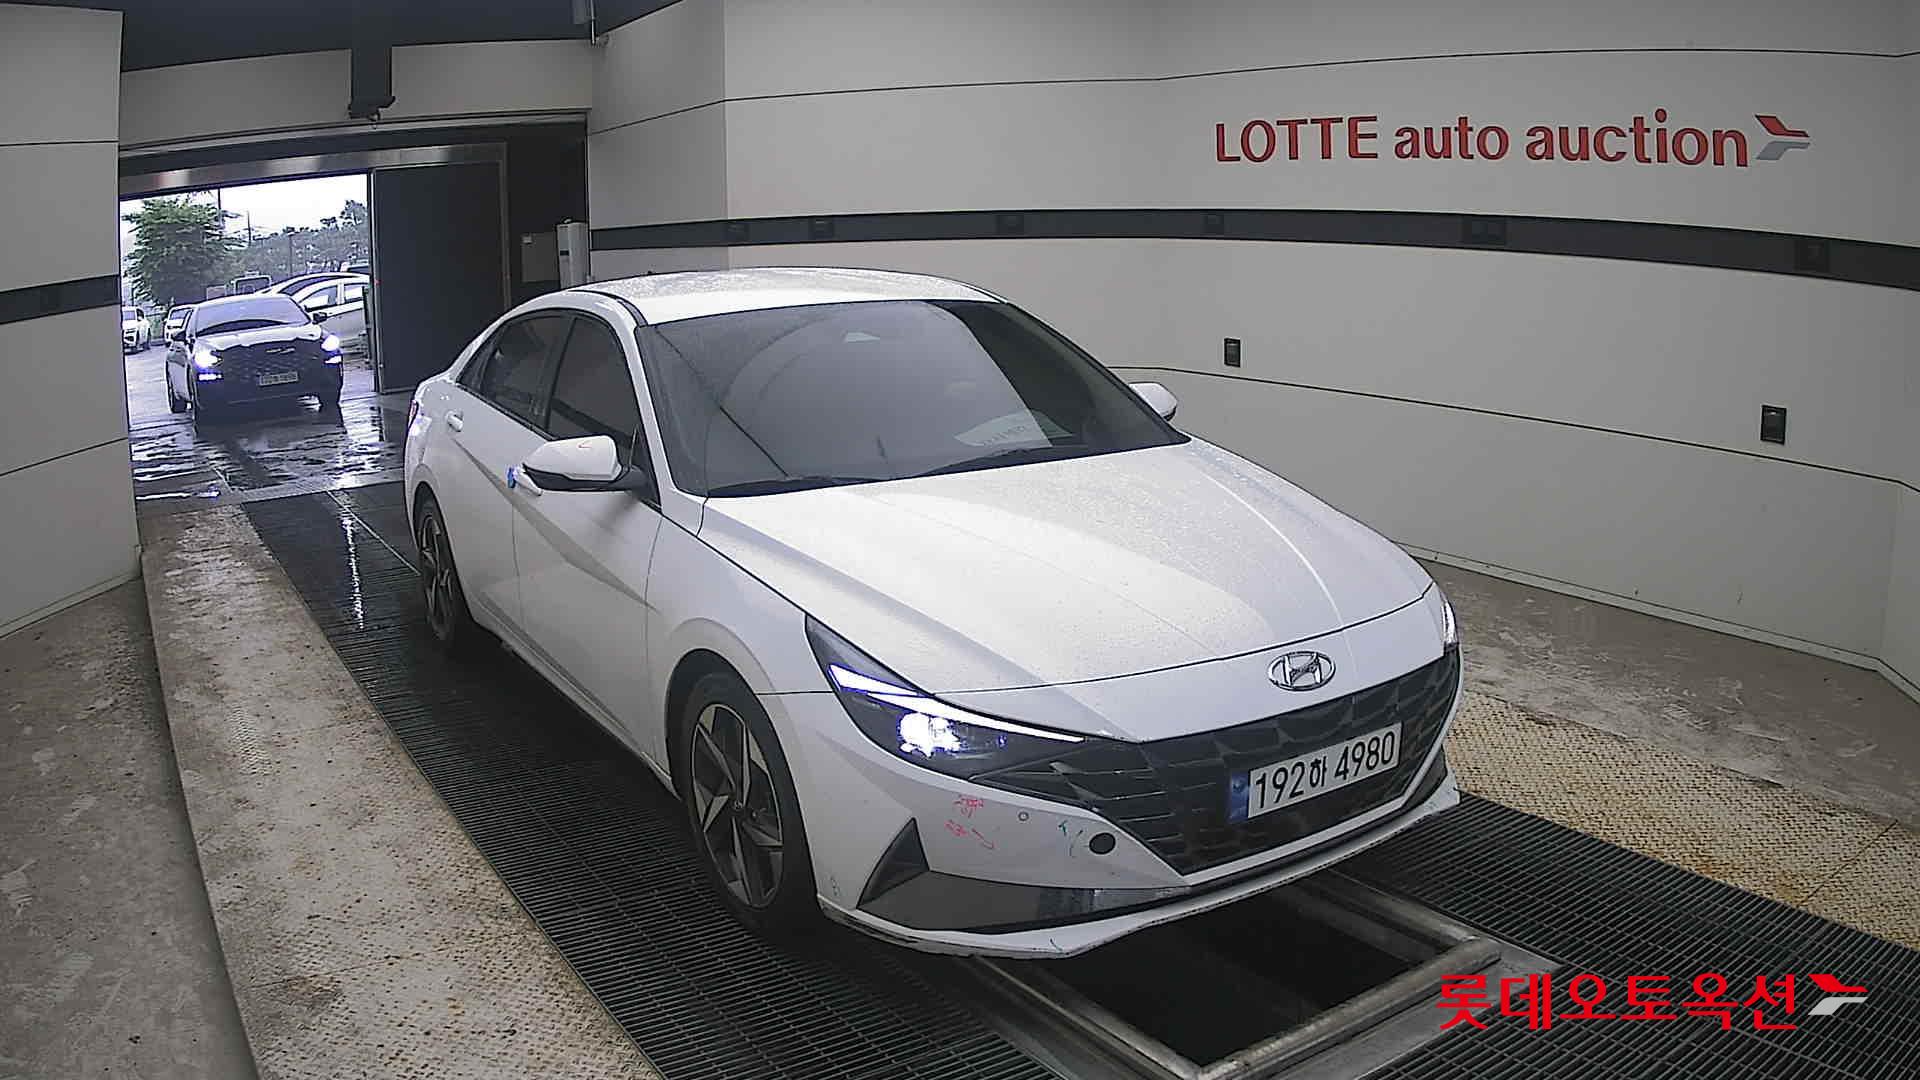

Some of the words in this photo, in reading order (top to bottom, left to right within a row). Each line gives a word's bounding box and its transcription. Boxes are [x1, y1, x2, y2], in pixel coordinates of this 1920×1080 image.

[1216, 116, 1378, 163] LOTTE
[1394, 116, 1509, 160] auto
[1526, 108, 1749, 167] auction
[1256, 756, 1327, 808] 192하
[1334, 732, 1395, 780] 4980
